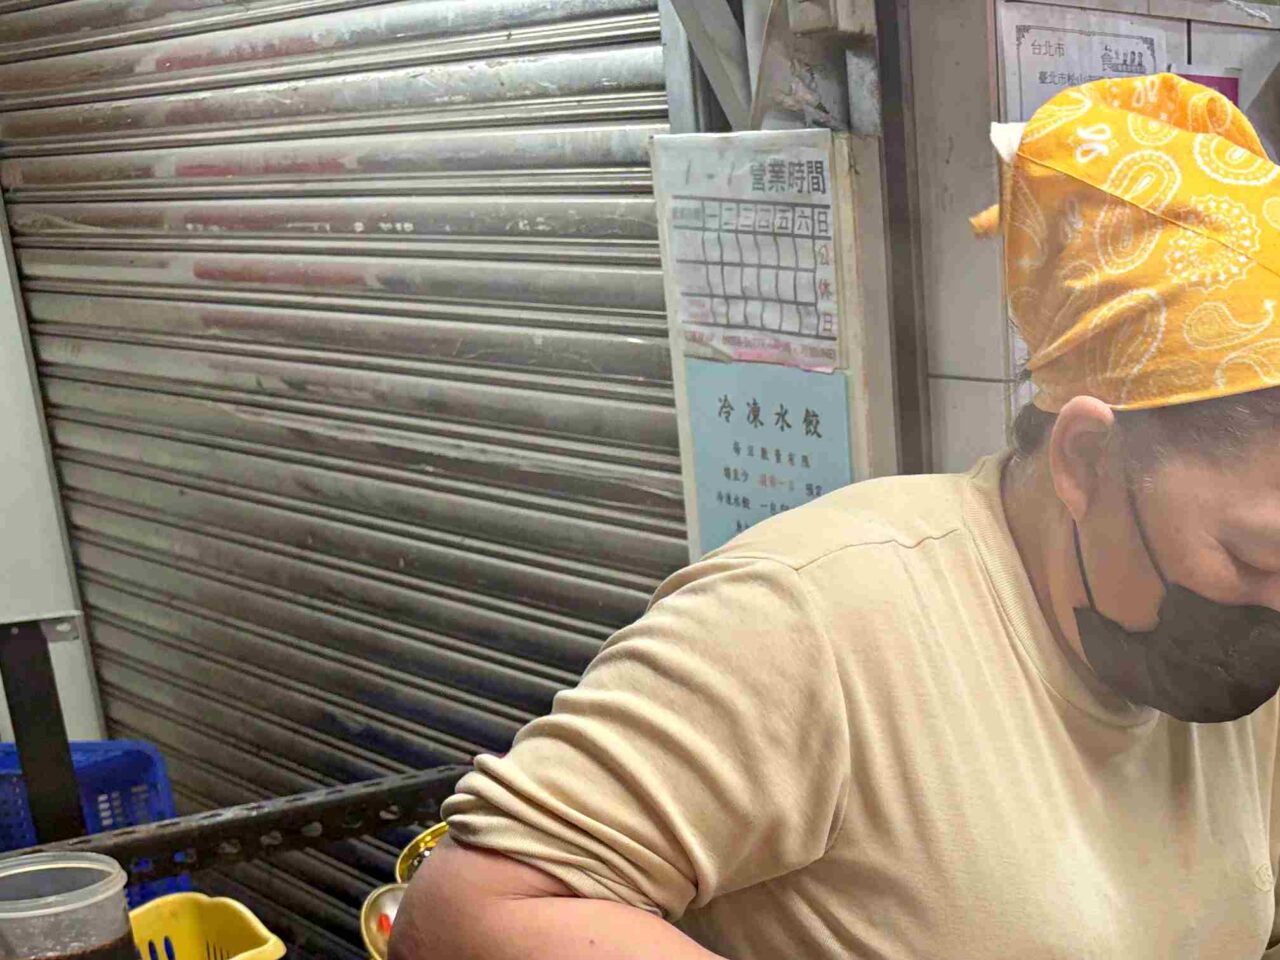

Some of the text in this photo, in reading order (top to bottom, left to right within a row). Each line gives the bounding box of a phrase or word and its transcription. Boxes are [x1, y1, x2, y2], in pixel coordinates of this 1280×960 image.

[1031, 40, 1065, 57] 台北市
[751, 157, 827, 195] 營業時間
[777, 208, 790, 230] 五
[797, 209, 810, 233] 六
[817, 210, 829, 234] 日
[718, 394, 823, 439] 冷凍水餃
